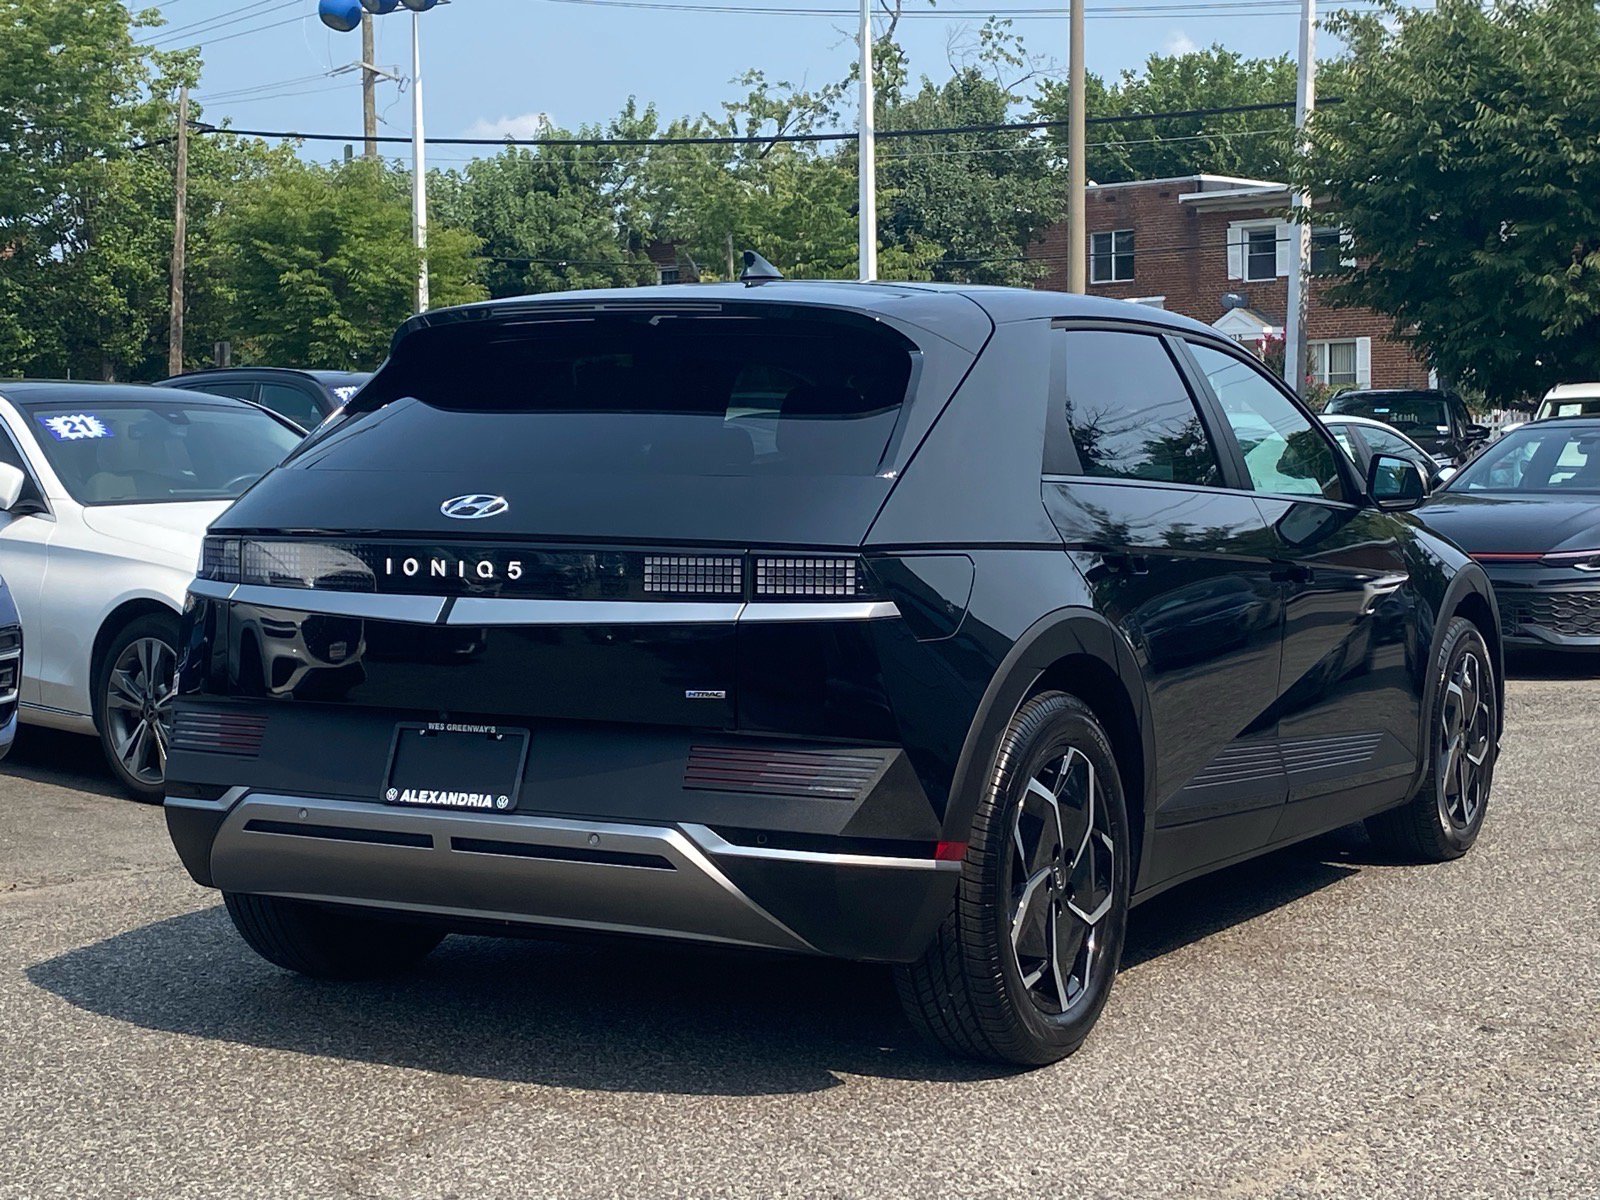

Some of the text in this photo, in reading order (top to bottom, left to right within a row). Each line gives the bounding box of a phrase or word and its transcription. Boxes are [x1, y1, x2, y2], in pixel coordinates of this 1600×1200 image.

[62, 419, 93, 433] 21
[386, 557, 522, 580] IONIQ 5
[428, 722, 496, 733] WES GREENWAY'S
[400, 789, 492, 808] ALEXANDRIA
